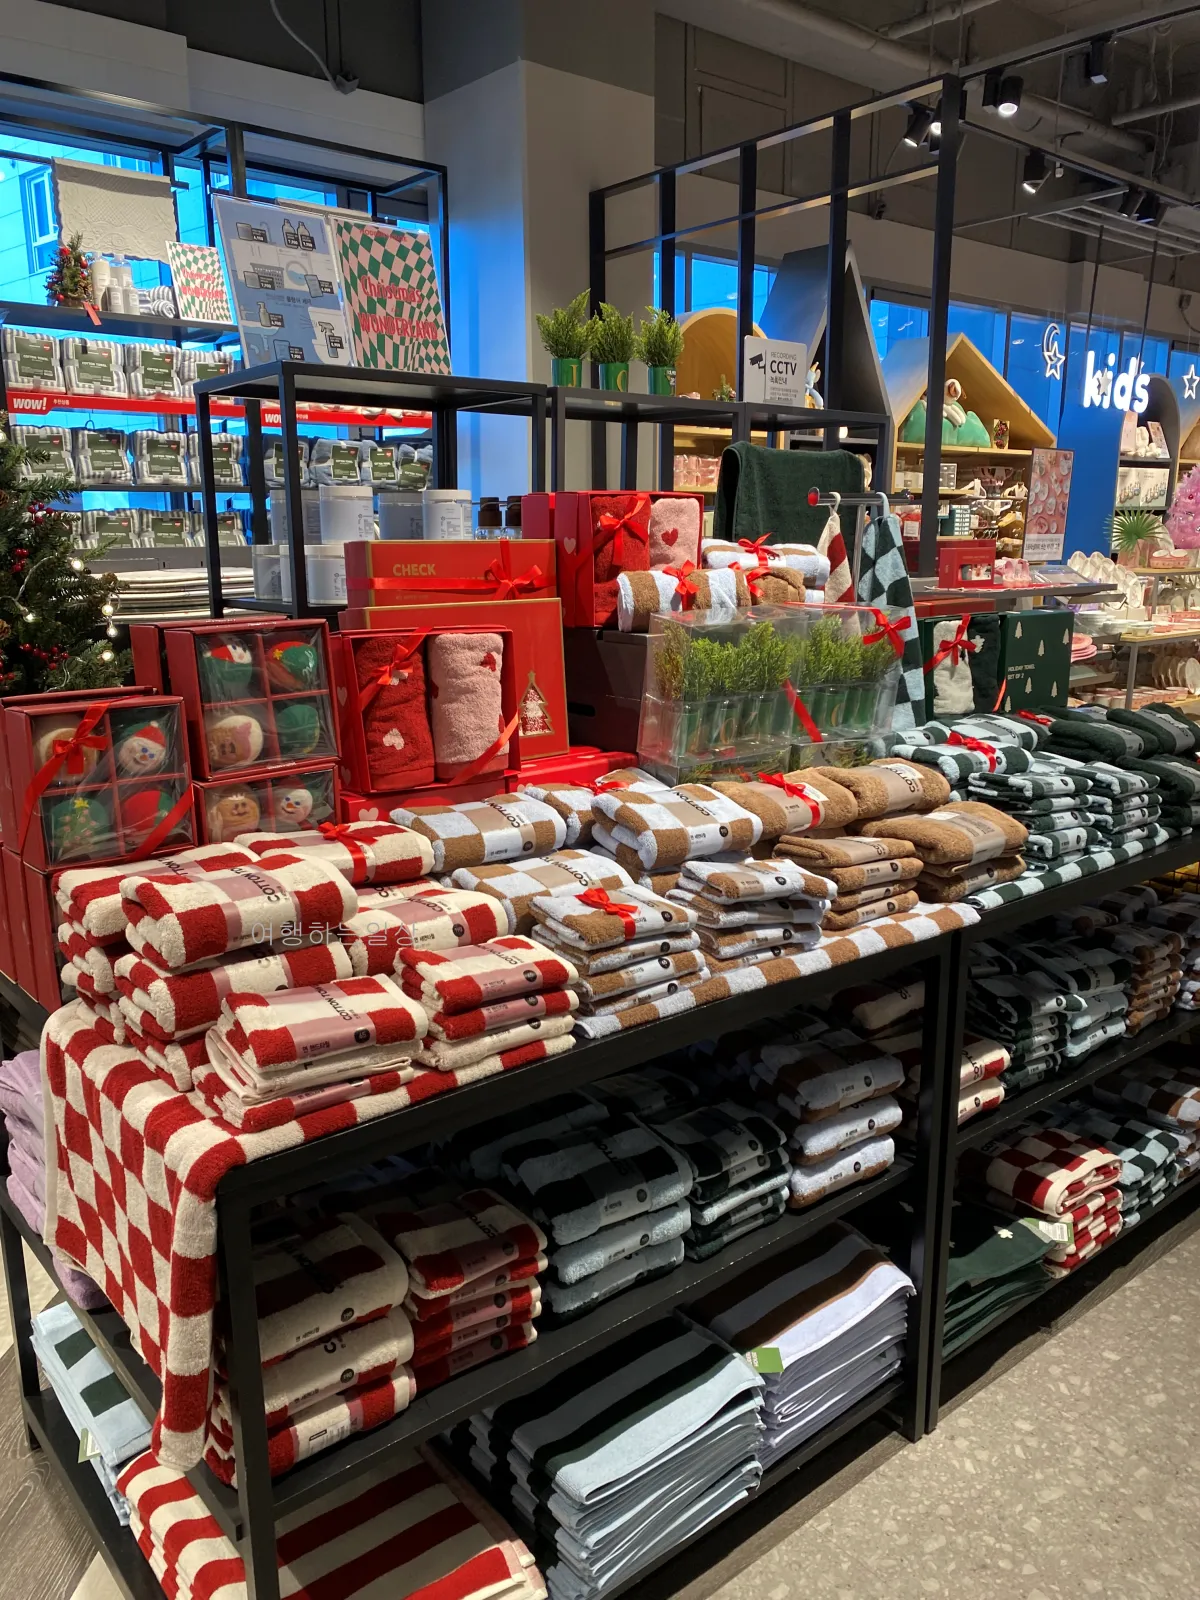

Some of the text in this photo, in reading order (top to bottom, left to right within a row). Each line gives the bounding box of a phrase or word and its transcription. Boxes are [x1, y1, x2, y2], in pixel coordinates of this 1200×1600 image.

[360, 275, 423, 304] Christmas
[357, 312, 438, 340] WONDERLAND
[770, 360, 797, 376] CCTV
[13, 396, 47, 411] WOW!
[392, 563, 436, 577] CHECK
[488, 800, 522, 829] COTTON
[243, 872, 281, 903] COTTON
[327, 997, 353, 1021] COTTON
